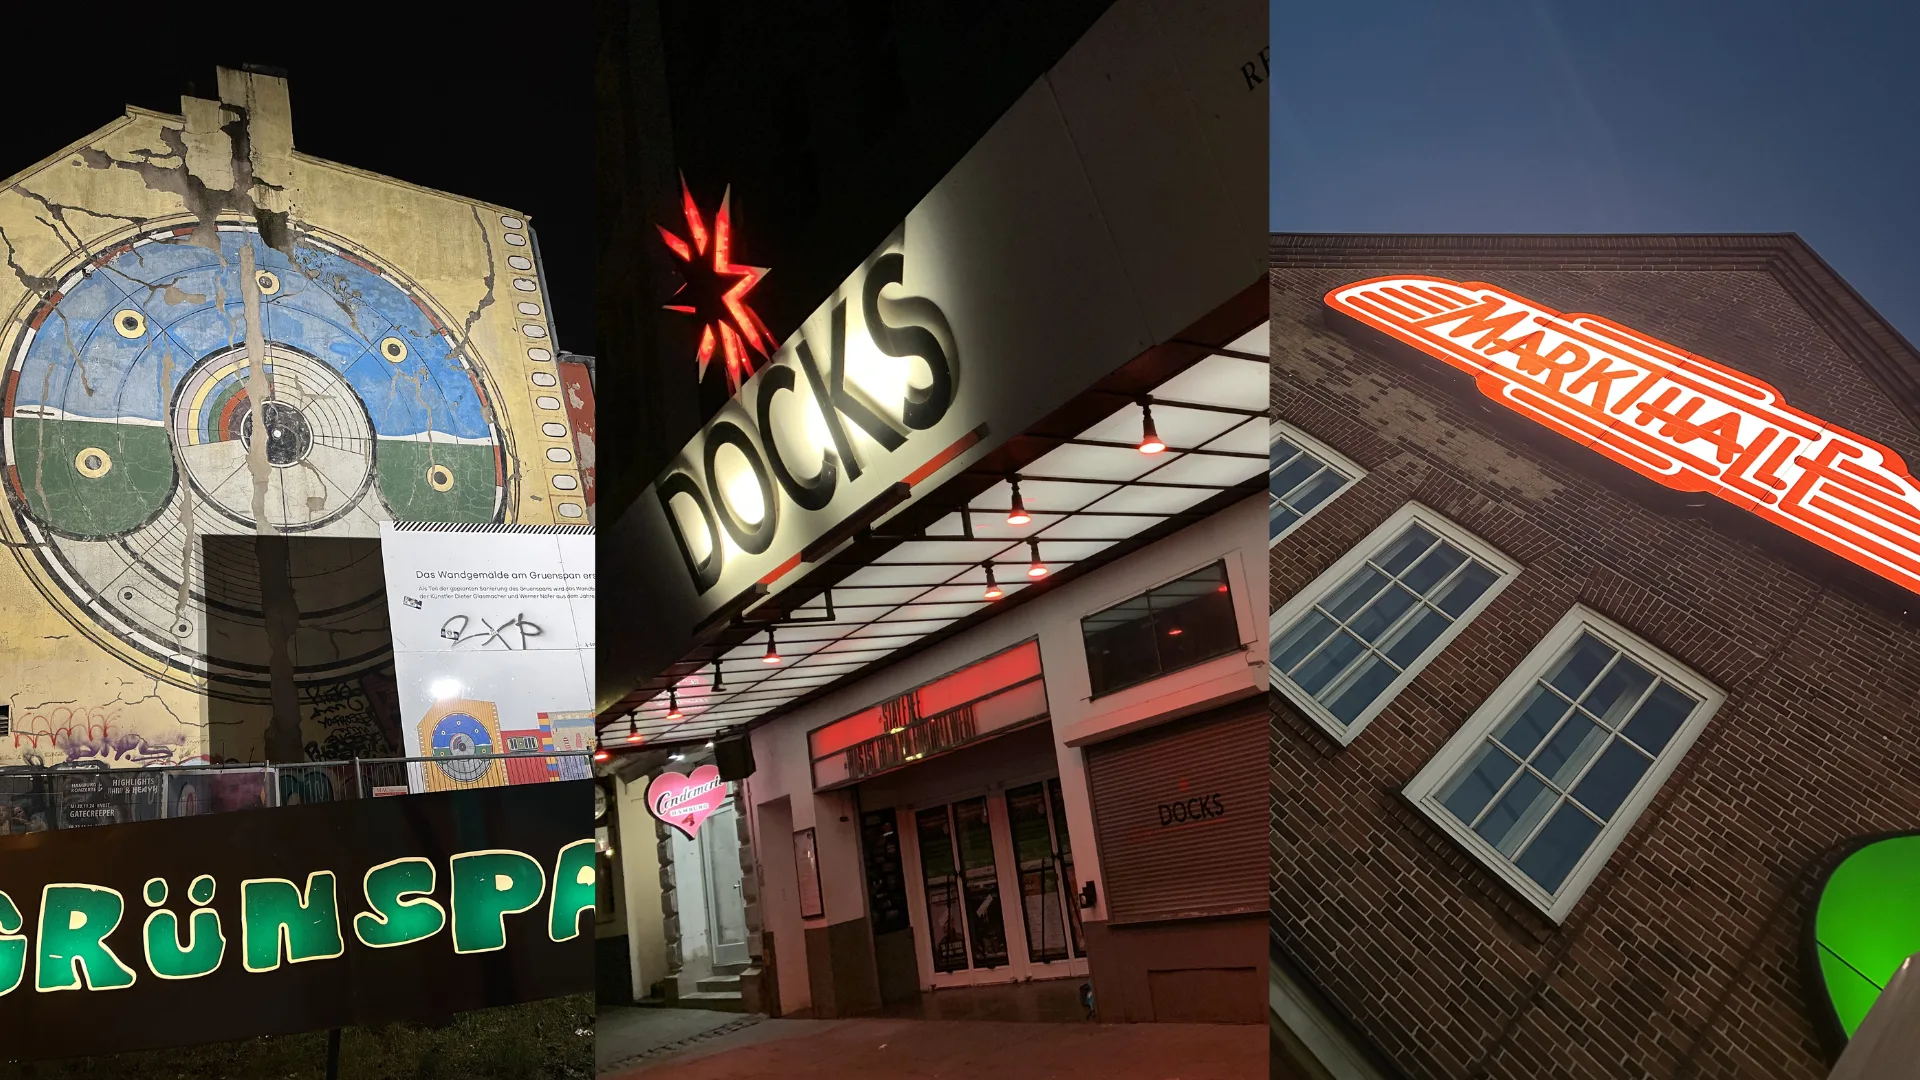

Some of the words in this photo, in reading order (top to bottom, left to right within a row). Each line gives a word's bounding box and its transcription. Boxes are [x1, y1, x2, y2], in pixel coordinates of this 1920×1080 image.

[1445, 294, 1890, 513] MARKTHALLE
[656, 252, 954, 597] DOCKS
[416, 570, 436, 579] Das
[438, 570, 509, 581] Wandgemälde
[511, 572, 528, 580] am
[529, 571, 581, 582] Gruenspan
[112, 778, 155, 787] HIGHLIGHTS
[69, 809, 115, 818] GATECREEPER
[671, 803, 708, 816] HAMBURG
[1157, 793, 1225, 826] DOCKS
